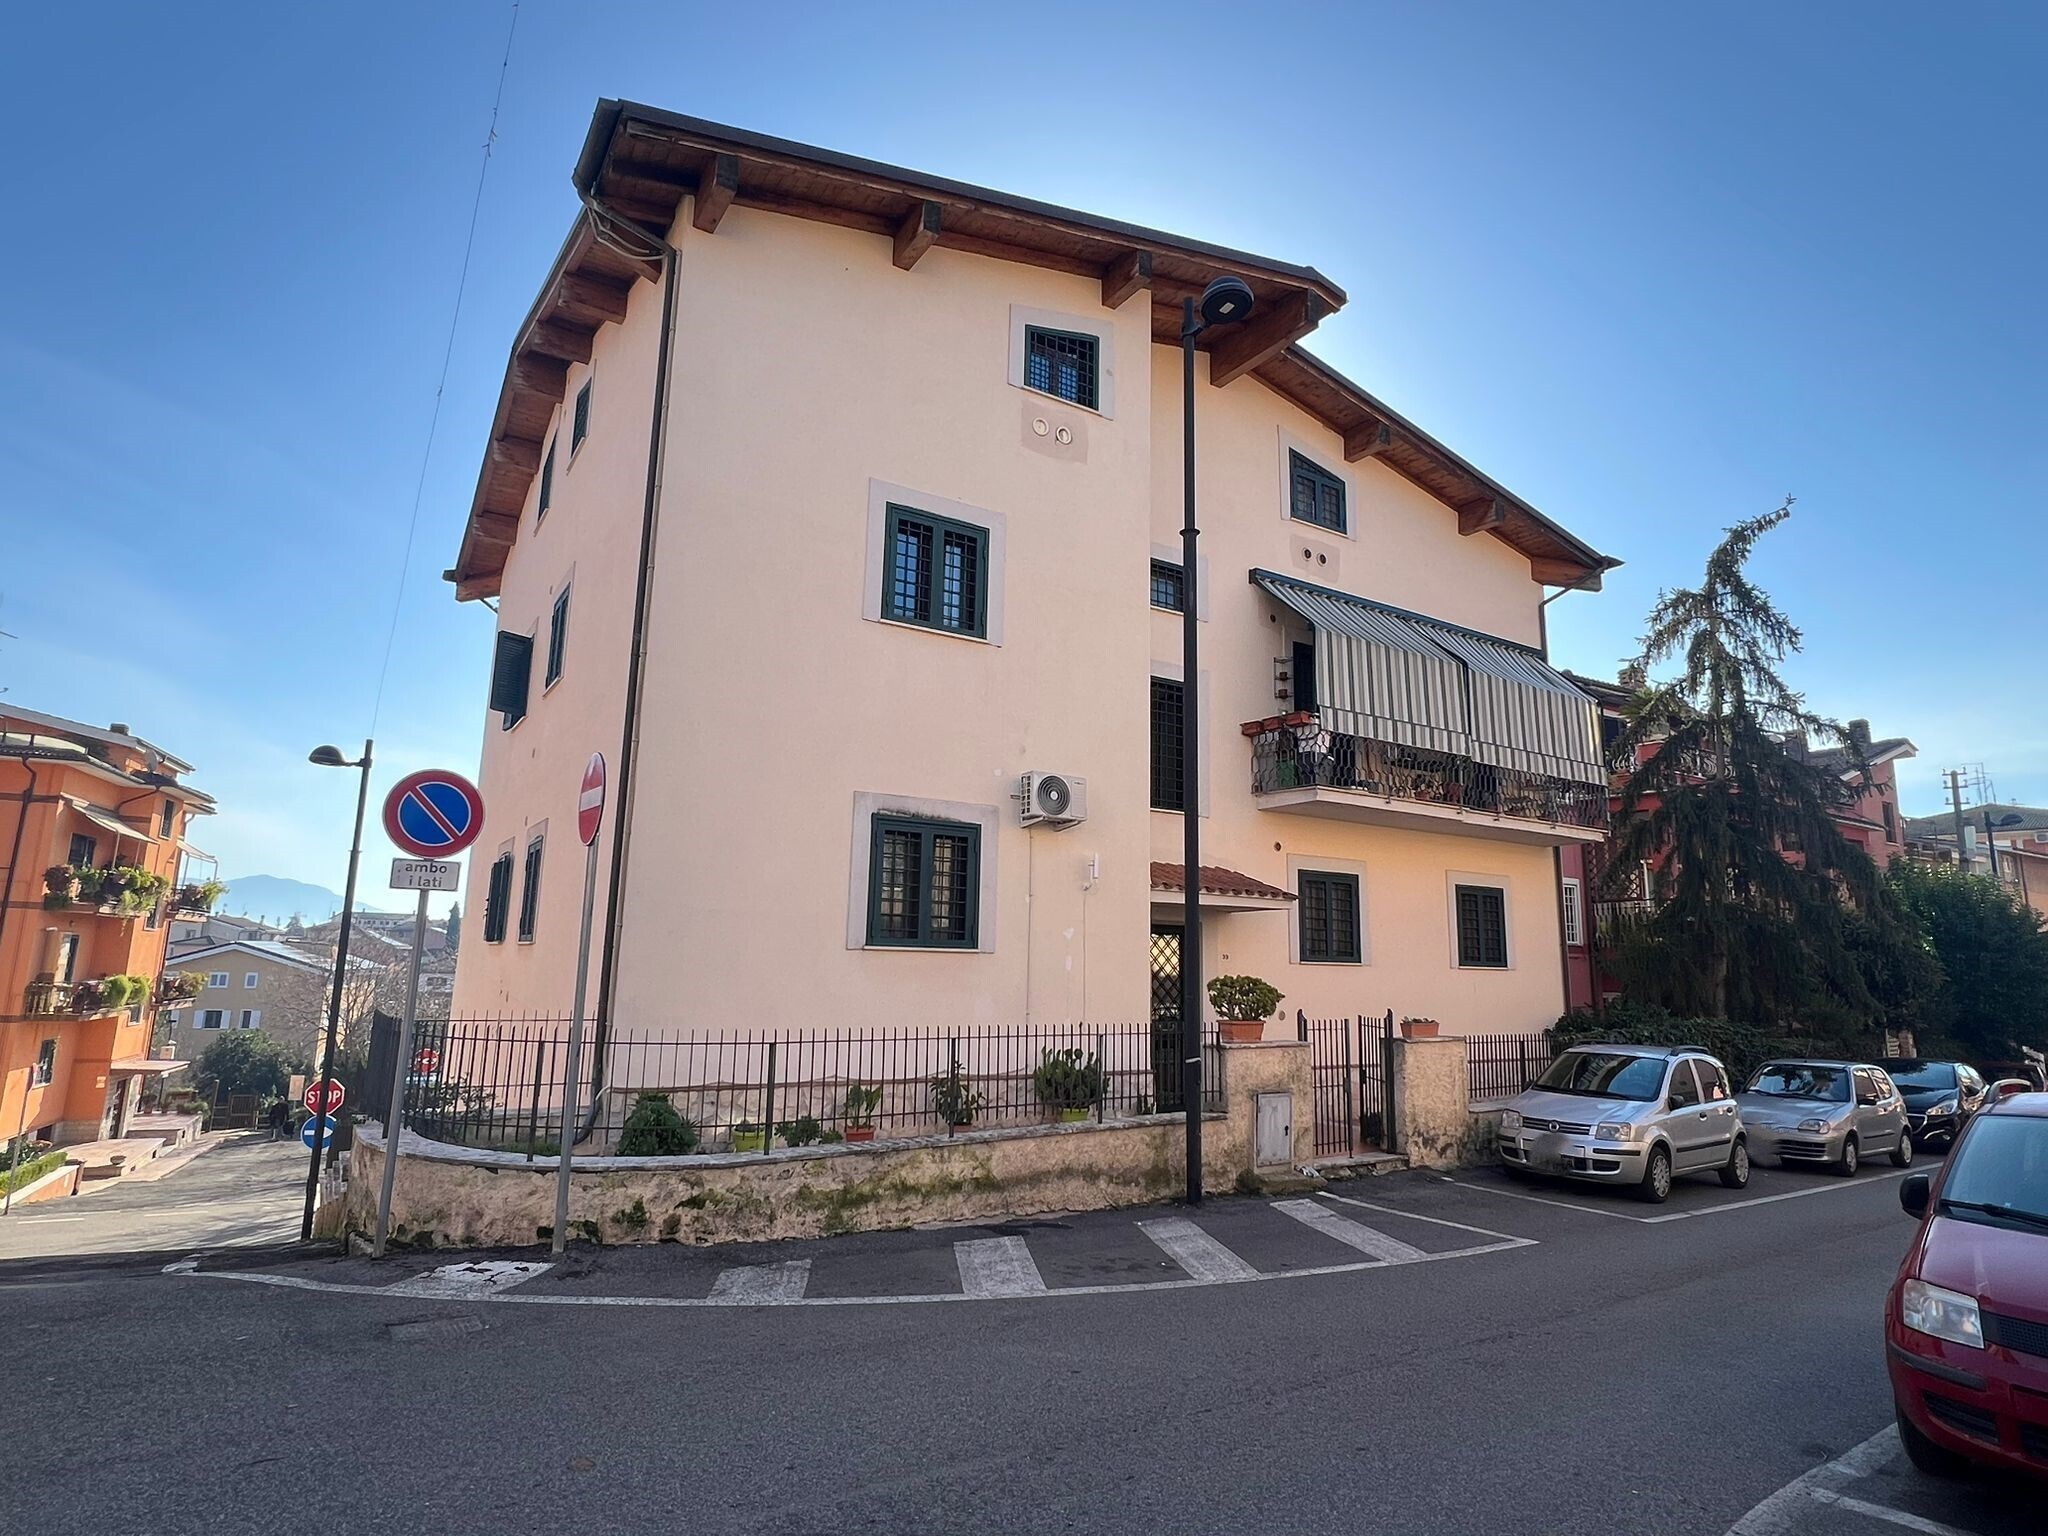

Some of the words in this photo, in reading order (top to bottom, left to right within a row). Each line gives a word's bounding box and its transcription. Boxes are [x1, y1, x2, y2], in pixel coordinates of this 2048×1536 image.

[405, 862, 447, 873] ambo
[409, 875, 413, 886] i
[417, 876, 442, 887] lati
